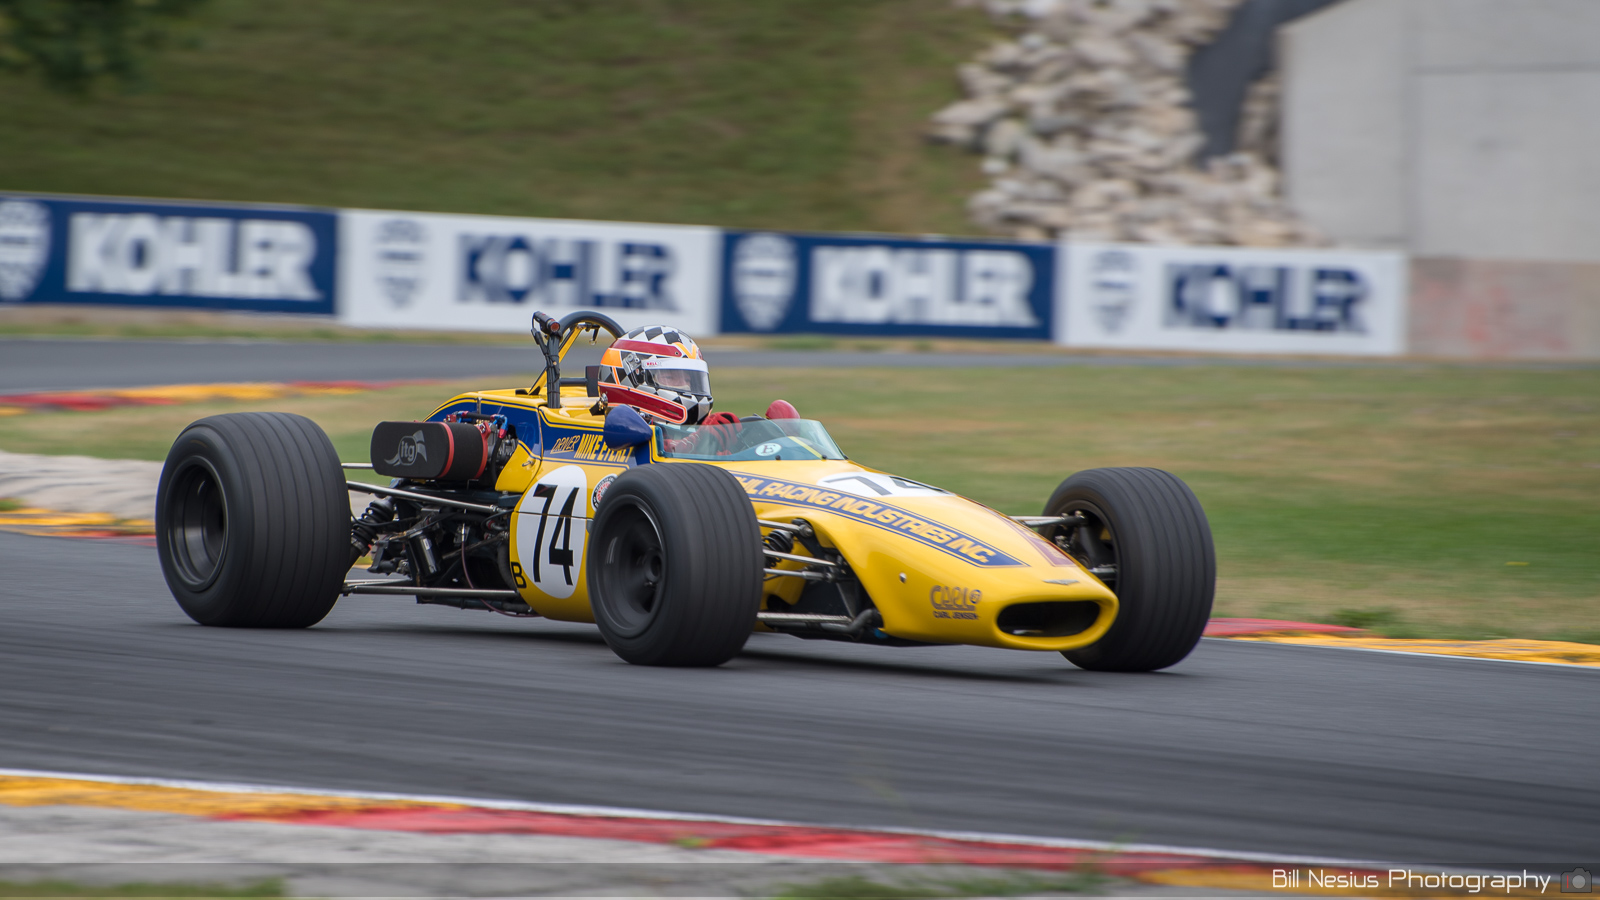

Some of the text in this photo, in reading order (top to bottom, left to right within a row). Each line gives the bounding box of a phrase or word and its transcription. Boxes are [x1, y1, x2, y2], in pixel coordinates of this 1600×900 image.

[66, 211, 323, 300] KOHLER
[454, 232, 681, 312] KOHLER
[808, 245, 1040, 327] KOHLER
[1161, 261, 1372, 334] KOHLER
[400, 440, 416, 462] itg
[573, 433, 604, 460] MIKE
[533, 483, 579, 586] 74
[758, 482, 842, 506] RACING
[829, 496, 959, 544] INDUSTRIES
[510, 561, 527, 589] B
